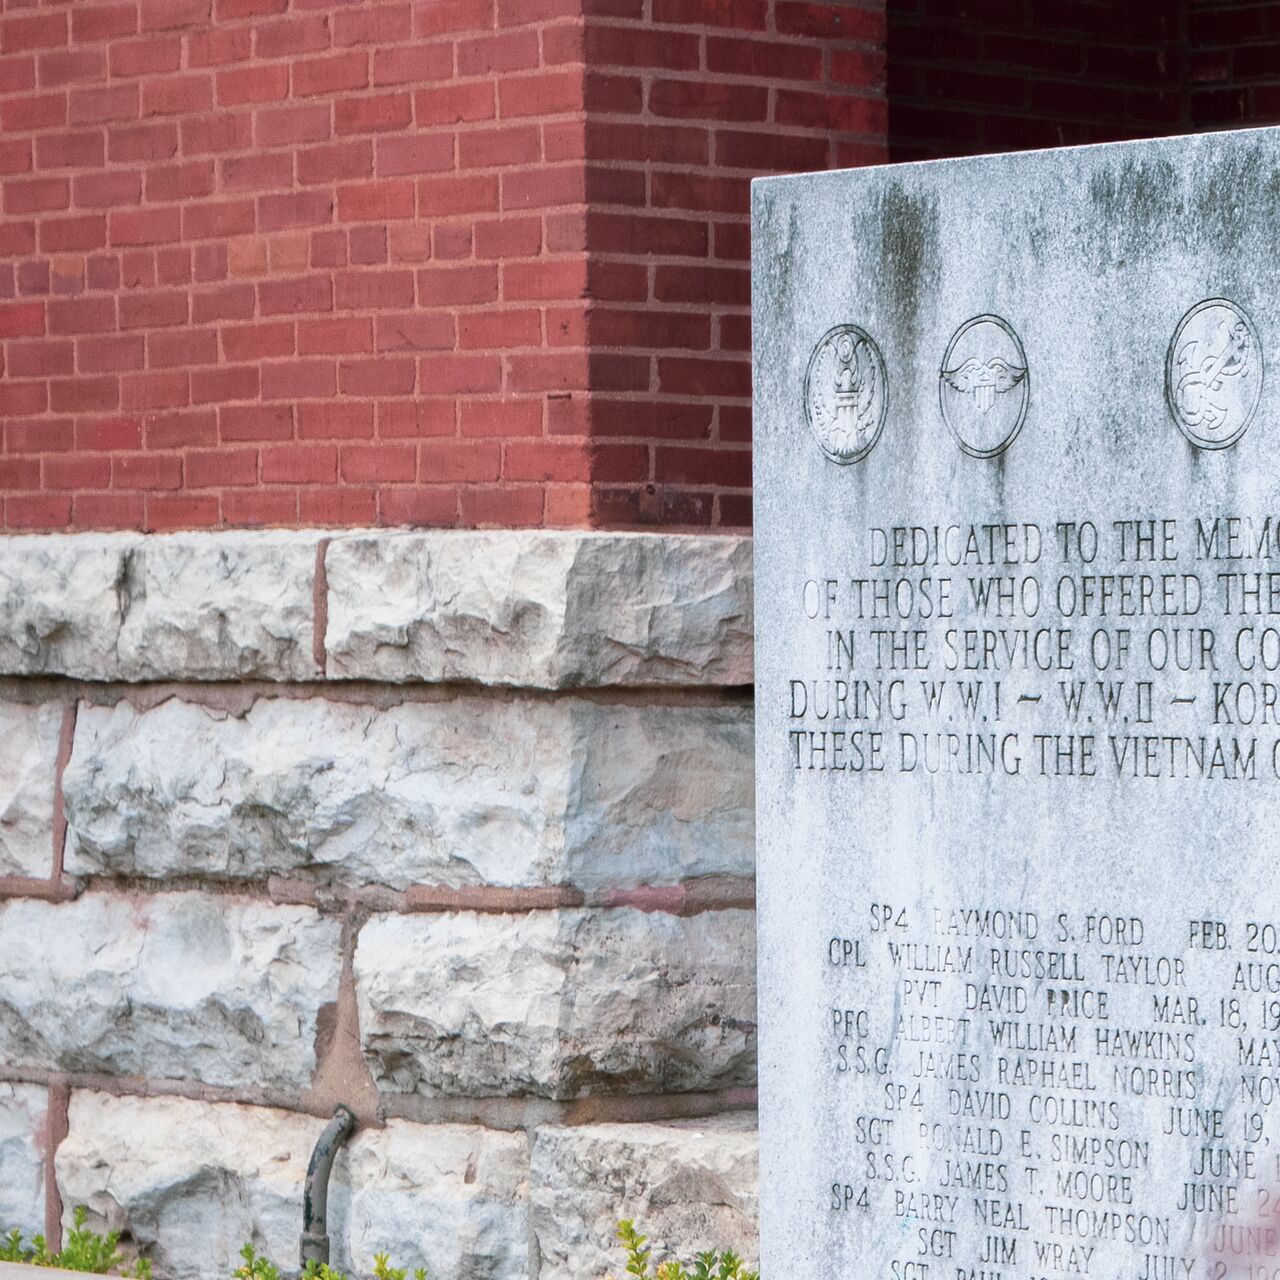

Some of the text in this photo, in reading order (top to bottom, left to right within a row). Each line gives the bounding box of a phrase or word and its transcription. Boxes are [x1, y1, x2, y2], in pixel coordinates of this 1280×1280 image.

[869, 523, 1041, 568] DEDICATED
[1056, 521, 1100, 564] TO
[1113, 519, 1178, 563] THE
[803, 580, 837, 621] OF
[852, 577, 952, 620] THOSE
[969, 577, 1039, 618] WHO
[1056, 573, 1202, 618] OFFERED
[827, 630, 855, 671] IN
[871, 630, 931, 672] THE
[945, 627, 1074, 672] SERVICE
[1092, 628, 1131, 672] OF
[1147, 627, 1217, 672] OUR
[790, 681, 906, 723] DURING
[790, 732, 885, 774] THESE
[900, 732, 1021, 777] DURING
[1035, 734, 1096, 779] THE
[1108, 735, 1257, 783] VIETNAM
[870, 904, 909, 932] SP4
[934, 907, 1039, 941] RAYMOND
[1057, 914, 1075, 943] S.
[1086, 916, 1144, 946] FORD
[1189, 921, 1232, 950] FEB.
[829, 938, 866, 968] CPL
[888, 942, 973, 974] WILLIAM
[991, 950, 1085, 981] RUSSELL
[1102, 955, 1186, 987] TAYLOR
[904, 980, 941, 1008] PVT
[965, 984, 1028, 1014] DAVID
[1047, 988, 1109, 1020] PRICE
[1153, 995, 1206, 1026] MAR.
[1220, 999, 1247, 1032] 18,
[832, 1009, 868, 1038] PFC
[895, 1014, 970, 1046] ALBERT
[989, 1020, 1077, 1054] WILLIAM
[1095, 1027, 1196, 1063] HAWKINS
[837, 1045, 892, 1075] S.S.G.
[913, 1050, 980, 1083] JAMES
[999, 1056, 1096, 1090] RAPHAEL
[1114, 1064, 1197, 1100] NORRIS
[884, 1083, 924, 1112] SP4
[950, 1089, 1011, 1120] DAVID
[1029, 1094, 1120, 1130] COLLINS
[1163, 1107, 1224, 1138] JUNE
[1243, 1112, 1269, 1147] 19,
[856, 1117, 894, 1146] SGT
[919, 1122, 1003, 1156] RONALD
[1020, 1131, 1041, 1160] E.
[1052, 1134, 1149, 1170] SIMPSON
[1193, 1148, 1256, 1179] JUNE
[866, 1152, 921, 1183] S.S.G.
[940, 1160, 1007, 1193] JAMES
[1025, 1168, 1043, 1197] T.
[1056, 1171, 1133, 1205] MOORE
[1177, 1182, 1238, 1214] JUNE
[831, 1184, 870, 1213] SP4
[895, 1190, 959, 1223] BARRY
[974, 1199, 1030, 1231] NEAL
[1045, 1206, 1170, 1246] THOMPSON
[1213, 1224, 1277, 1257] JUNE
[918, 1228, 957, 1258] SGT
[980, 1236, 1017, 1266] JIM
[1034, 1240, 1094, 1275] WRAY
